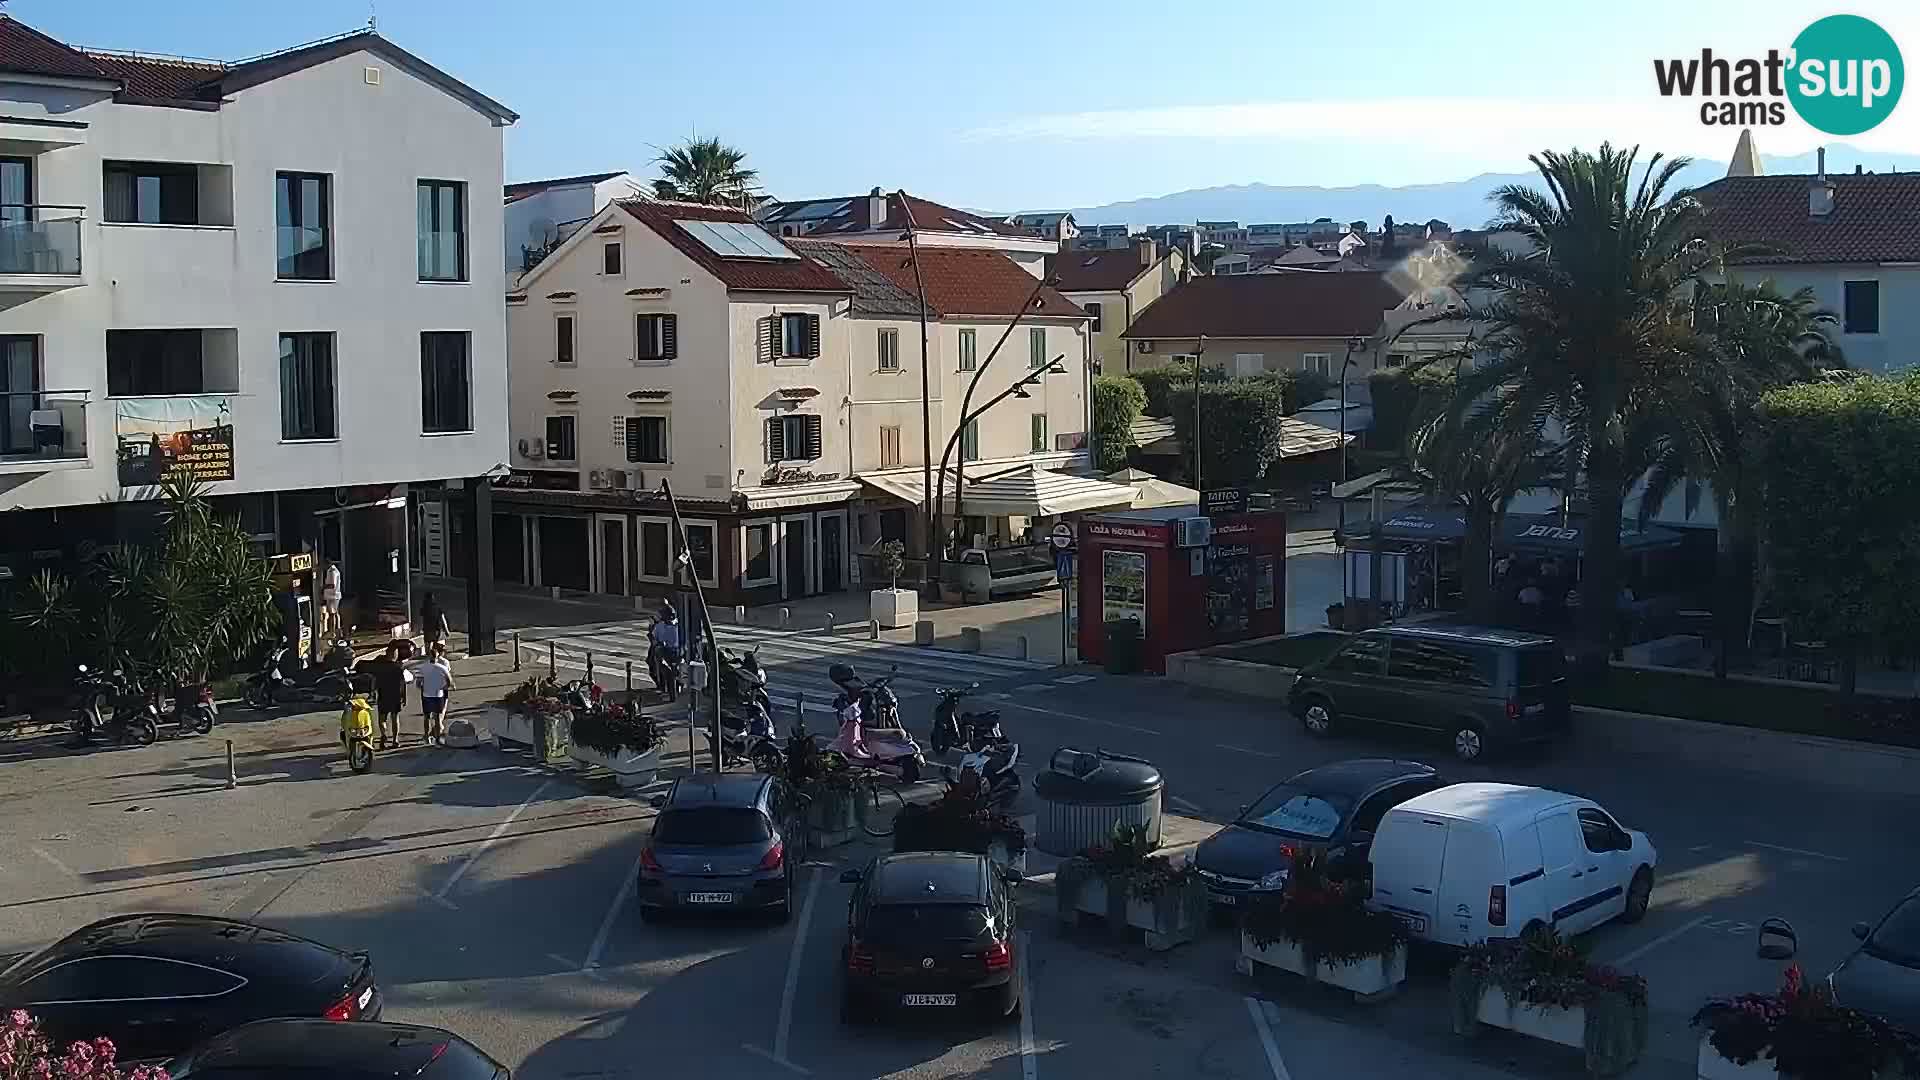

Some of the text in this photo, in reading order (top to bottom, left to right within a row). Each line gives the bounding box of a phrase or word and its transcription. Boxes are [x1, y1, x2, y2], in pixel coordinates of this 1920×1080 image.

[177, 451, 230, 461] HOME OF THE
[194, 460, 230, 470] AMAZING
[1208, 491, 1239, 501] TATTOO
[293, 556, 311, 569] ATM
